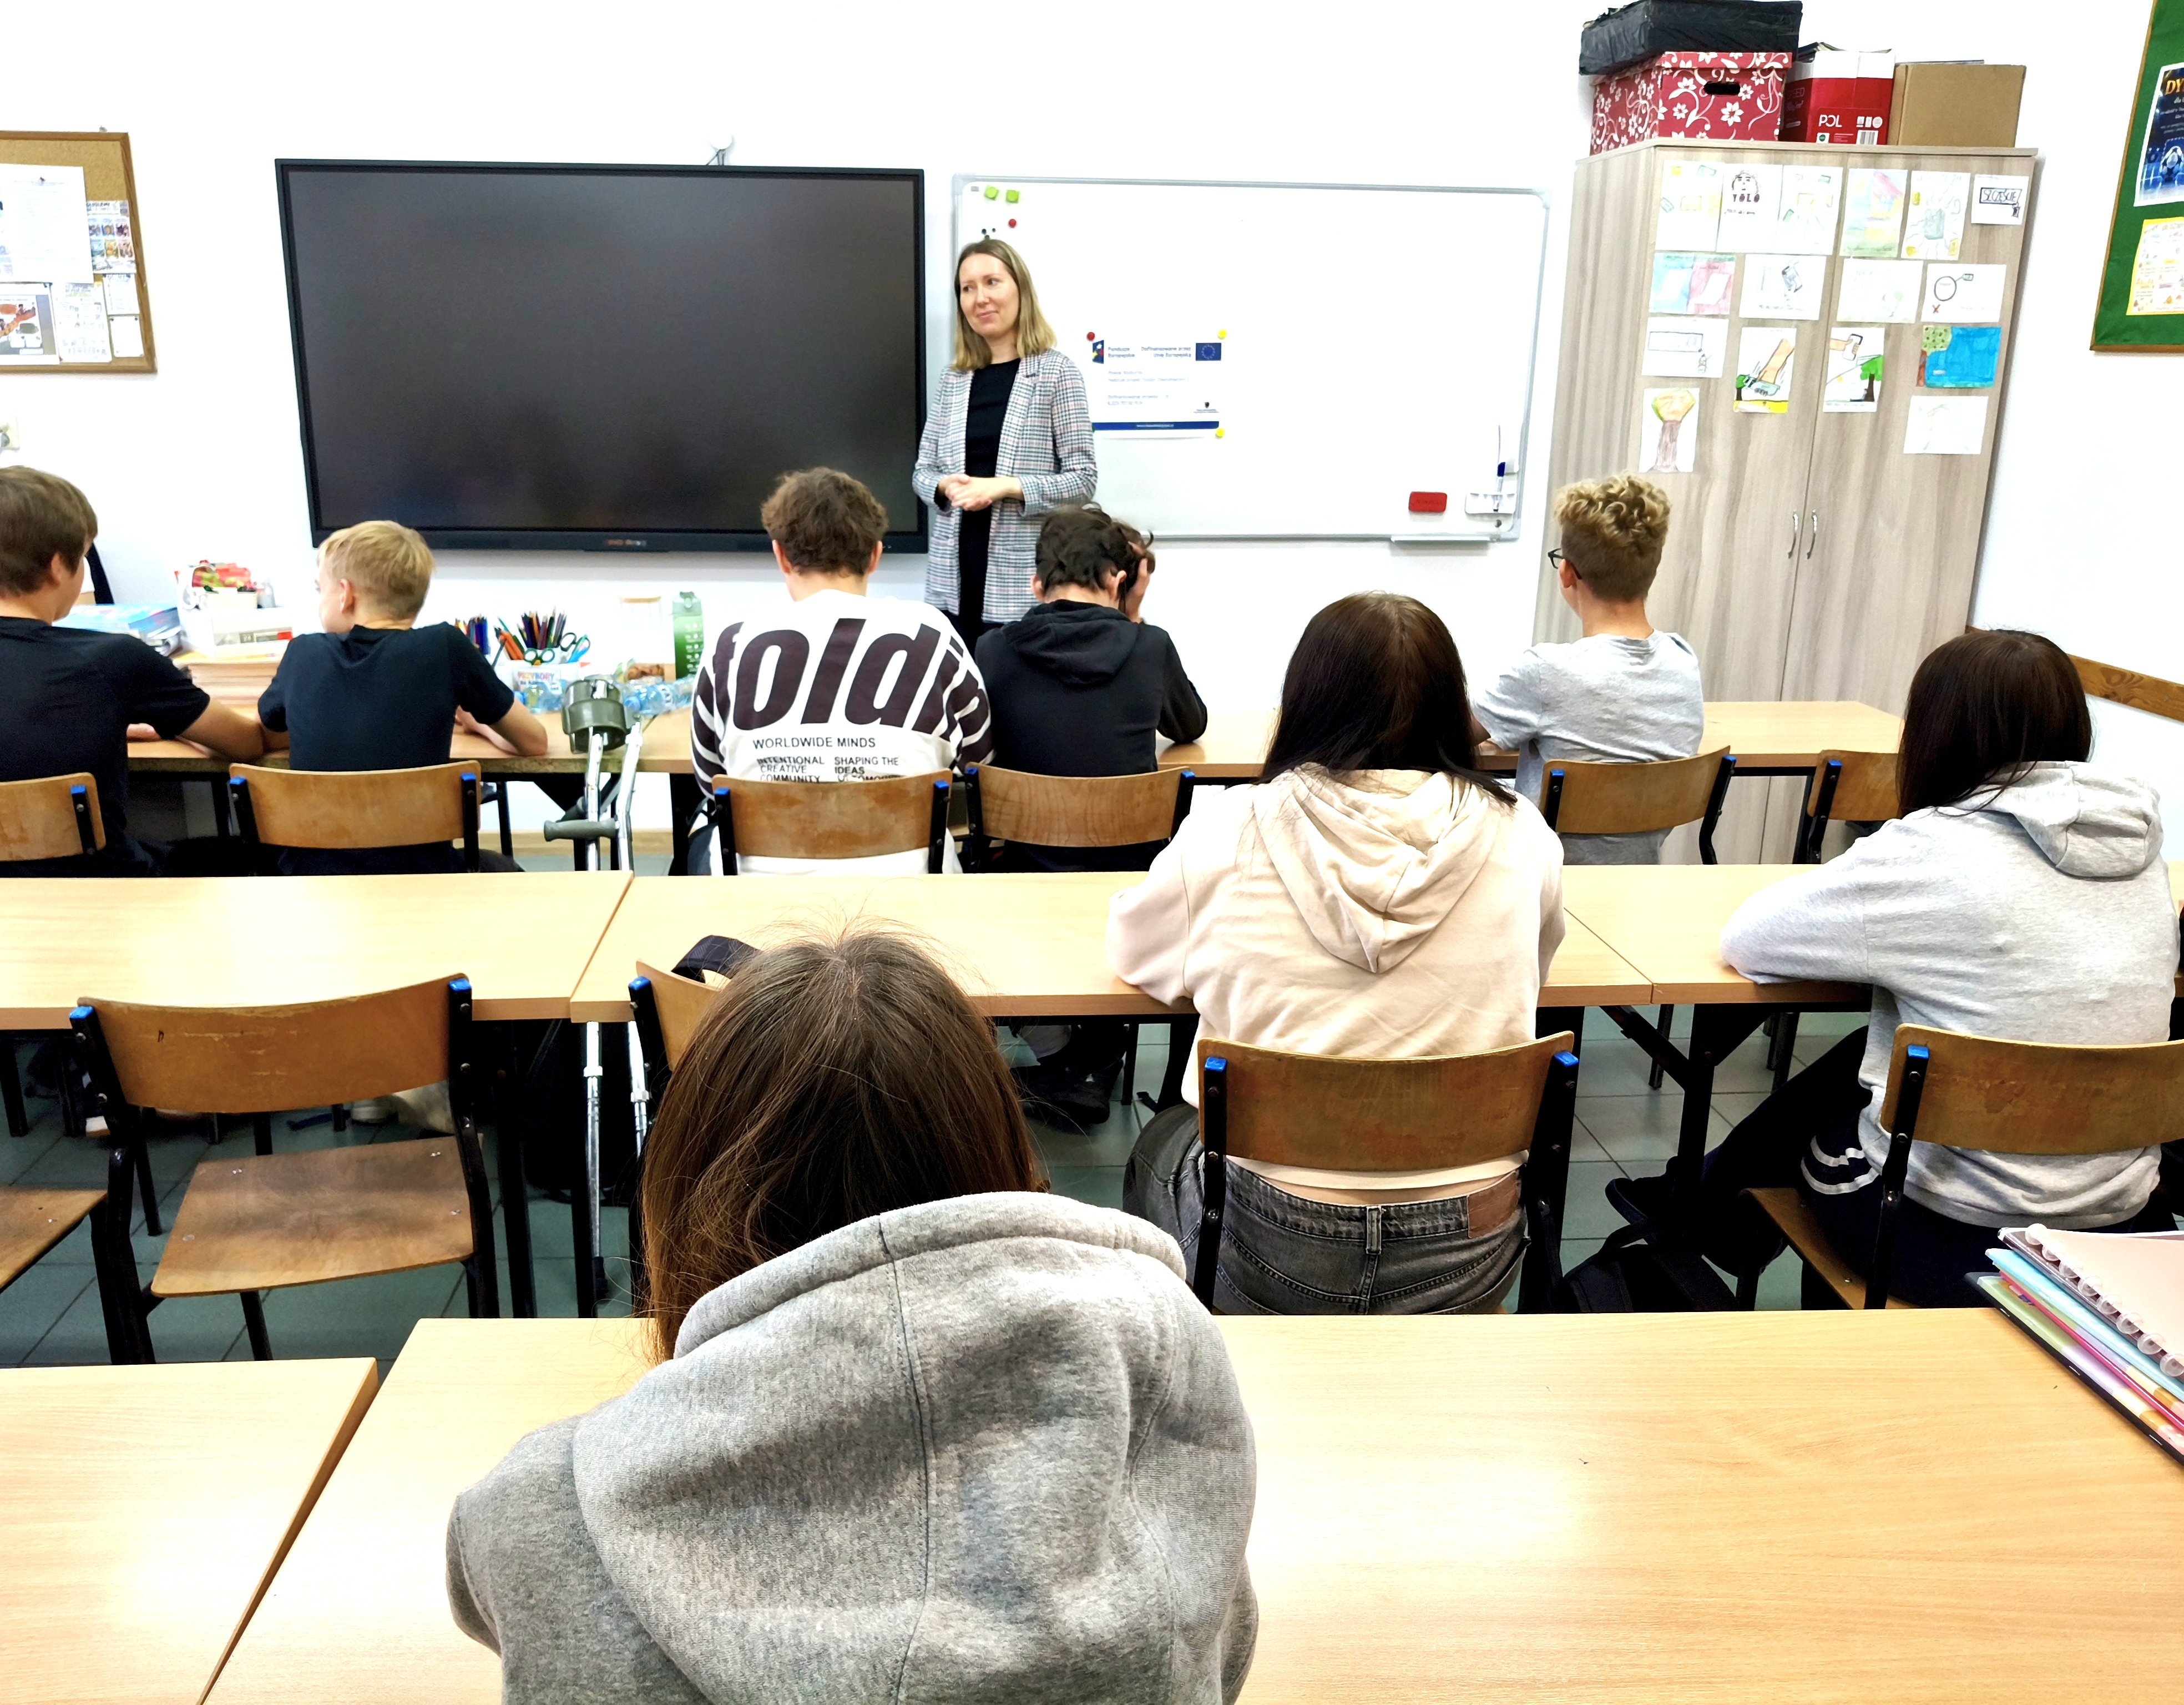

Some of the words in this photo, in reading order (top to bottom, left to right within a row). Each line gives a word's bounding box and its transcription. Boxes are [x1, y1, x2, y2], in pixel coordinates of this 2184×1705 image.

[1733, 193, 1760, 203] YOLO
[753, 737, 833, 749] WORLDWIDE
[837, 737, 876, 748] MINDS
[757, 755, 825, 765] INTENTIONAL
[834, 756, 879, 765] SHAPING
[882, 756, 899, 766] THE
[760, 765, 807, 774] CREATIVE
